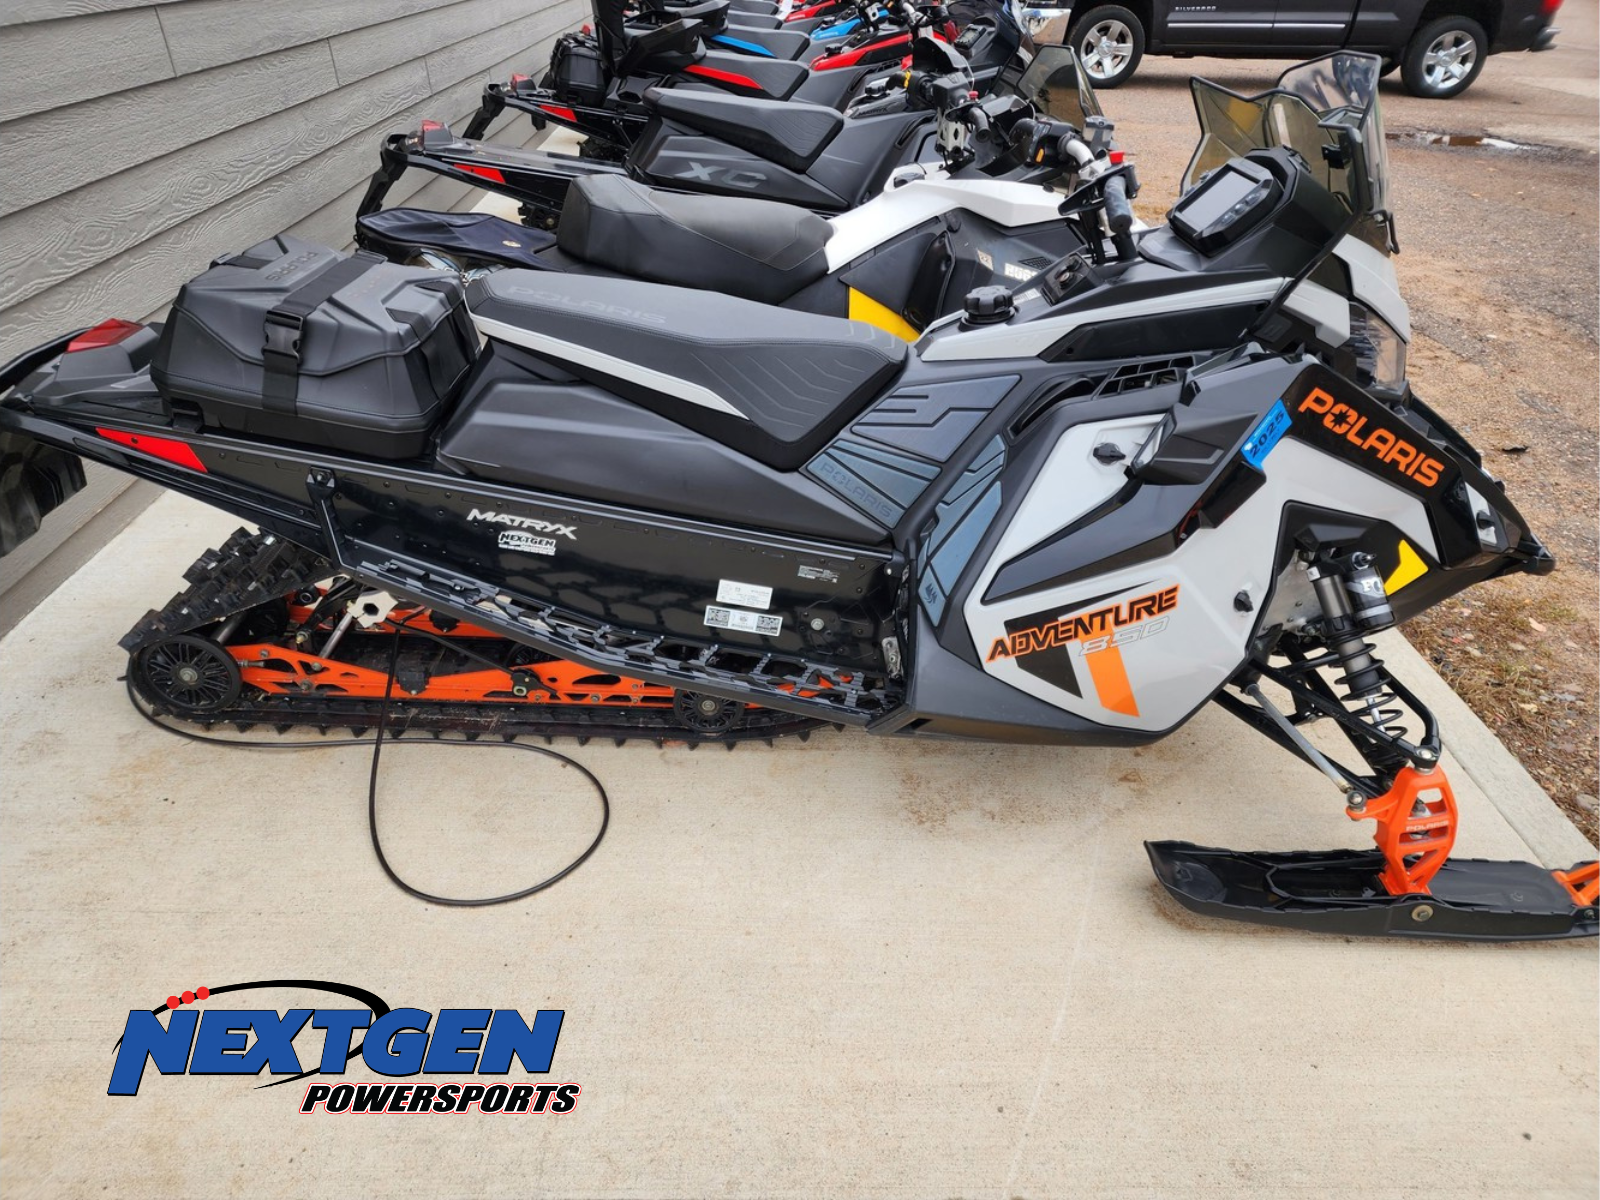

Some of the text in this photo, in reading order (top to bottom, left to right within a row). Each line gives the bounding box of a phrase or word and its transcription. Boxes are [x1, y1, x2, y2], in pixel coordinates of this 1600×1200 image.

[674, 161, 767, 188] XC
[507, 286, 667, 324] POLARIS
[1249, 410, 1285, 459] 2025
[1298, 387, 1445, 487] POLARIS
[820, 461, 893, 518] POLARIS
[466, 508, 578, 540] MATRYX
[500, 533, 555, 547] NEXTGEN
[986, 583, 1180, 663] ADVENTURE
[1079, 615, 1171, 656] 850
[1406, 820, 1449, 832] POLARIS
